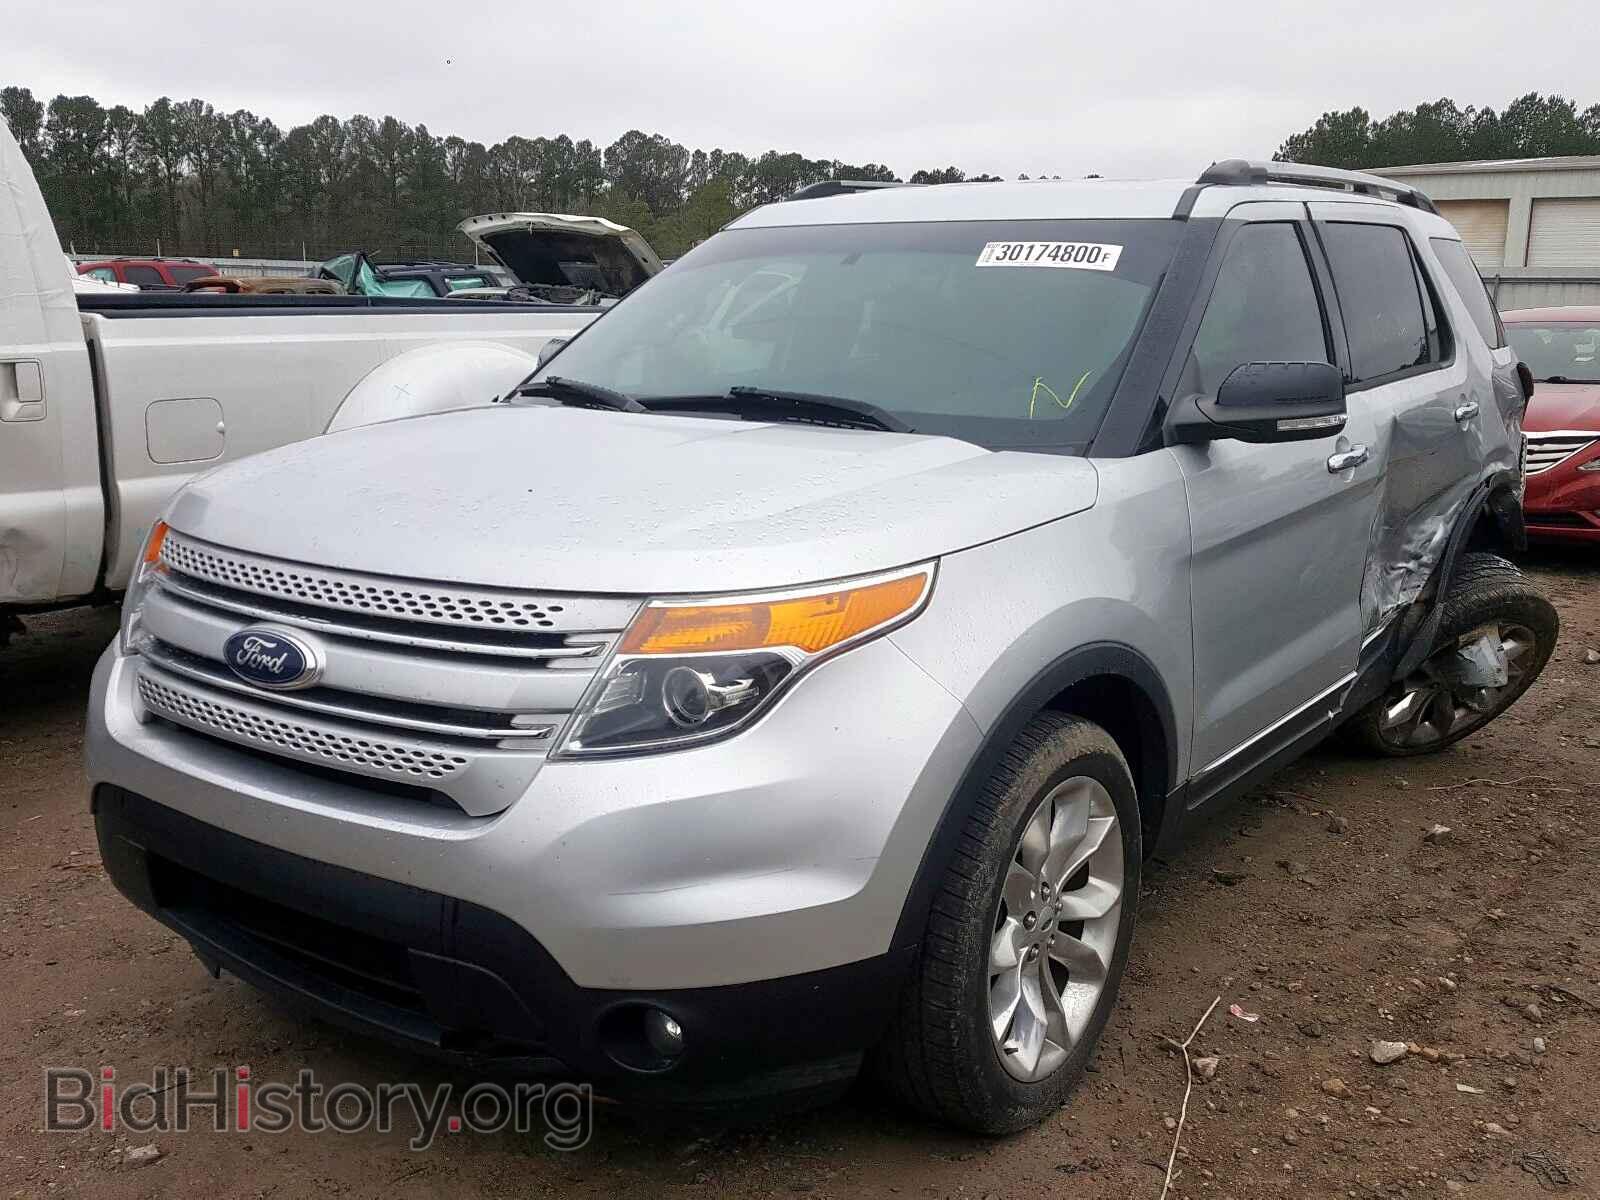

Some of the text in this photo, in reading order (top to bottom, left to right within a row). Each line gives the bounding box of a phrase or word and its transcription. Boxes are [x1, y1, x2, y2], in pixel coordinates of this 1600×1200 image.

[995, 243, 1102, 264] 30174800
[1101, 252, 1112, 263] F
[236, 636, 289, 674] Ford
